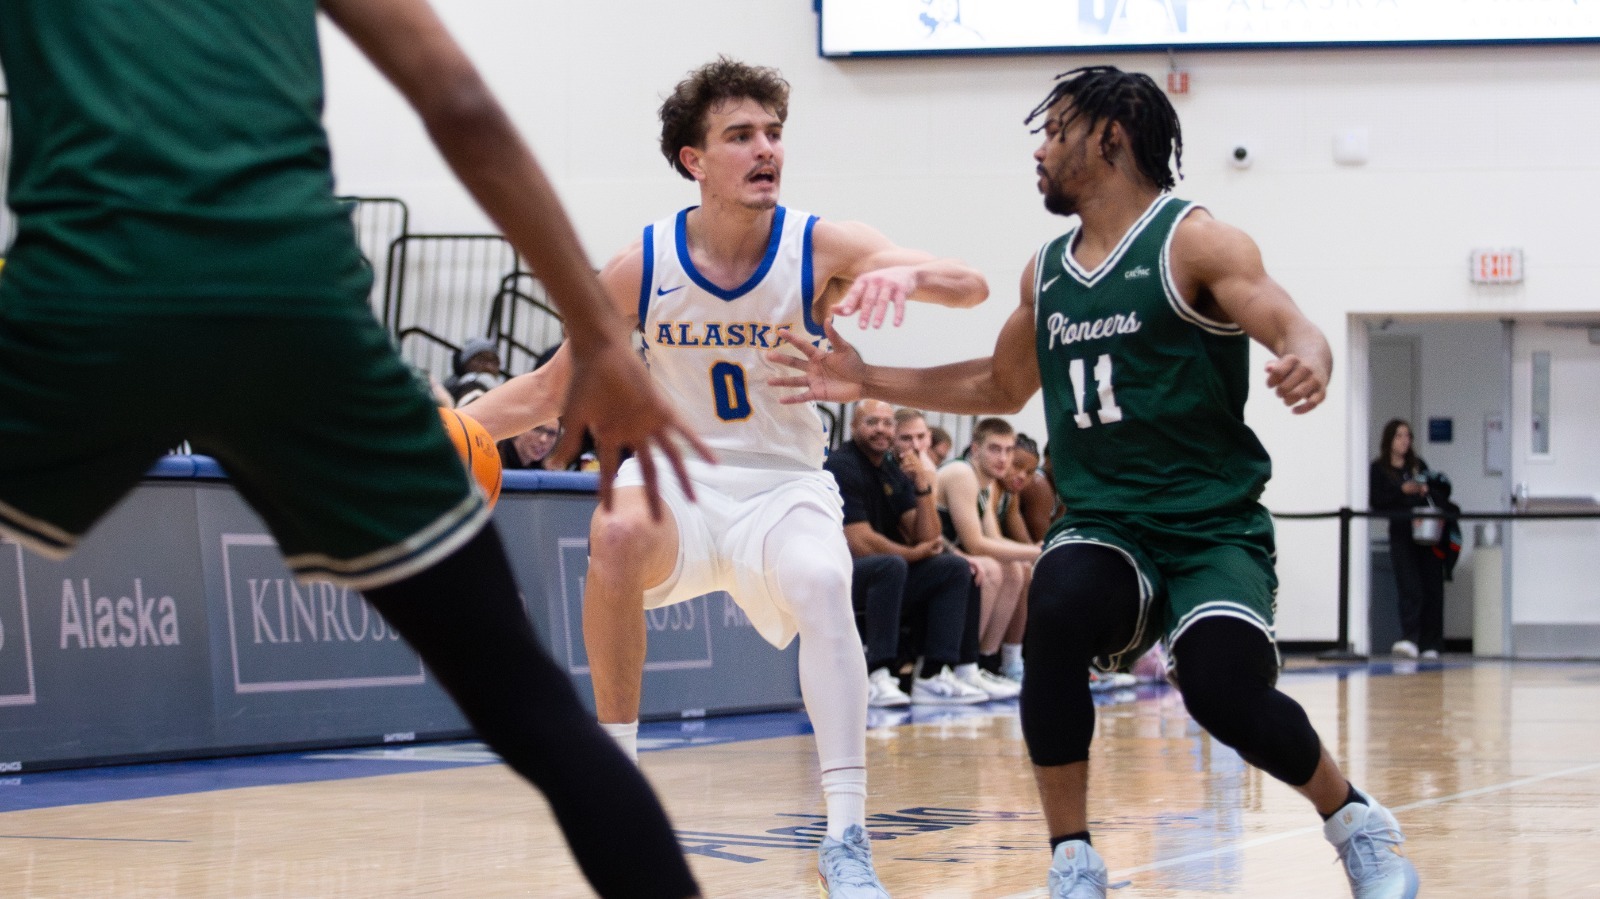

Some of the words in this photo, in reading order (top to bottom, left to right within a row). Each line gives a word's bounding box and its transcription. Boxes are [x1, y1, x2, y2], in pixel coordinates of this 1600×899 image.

[1480, 254, 1513, 278] EXIT
[1047, 311, 1142, 351] Pioneers
[708, 359, 754, 424] 0
[1068, 353, 1123, 430] 11
[59, 577, 181, 650] Alaska
[247, 577, 400, 644] KINROS
